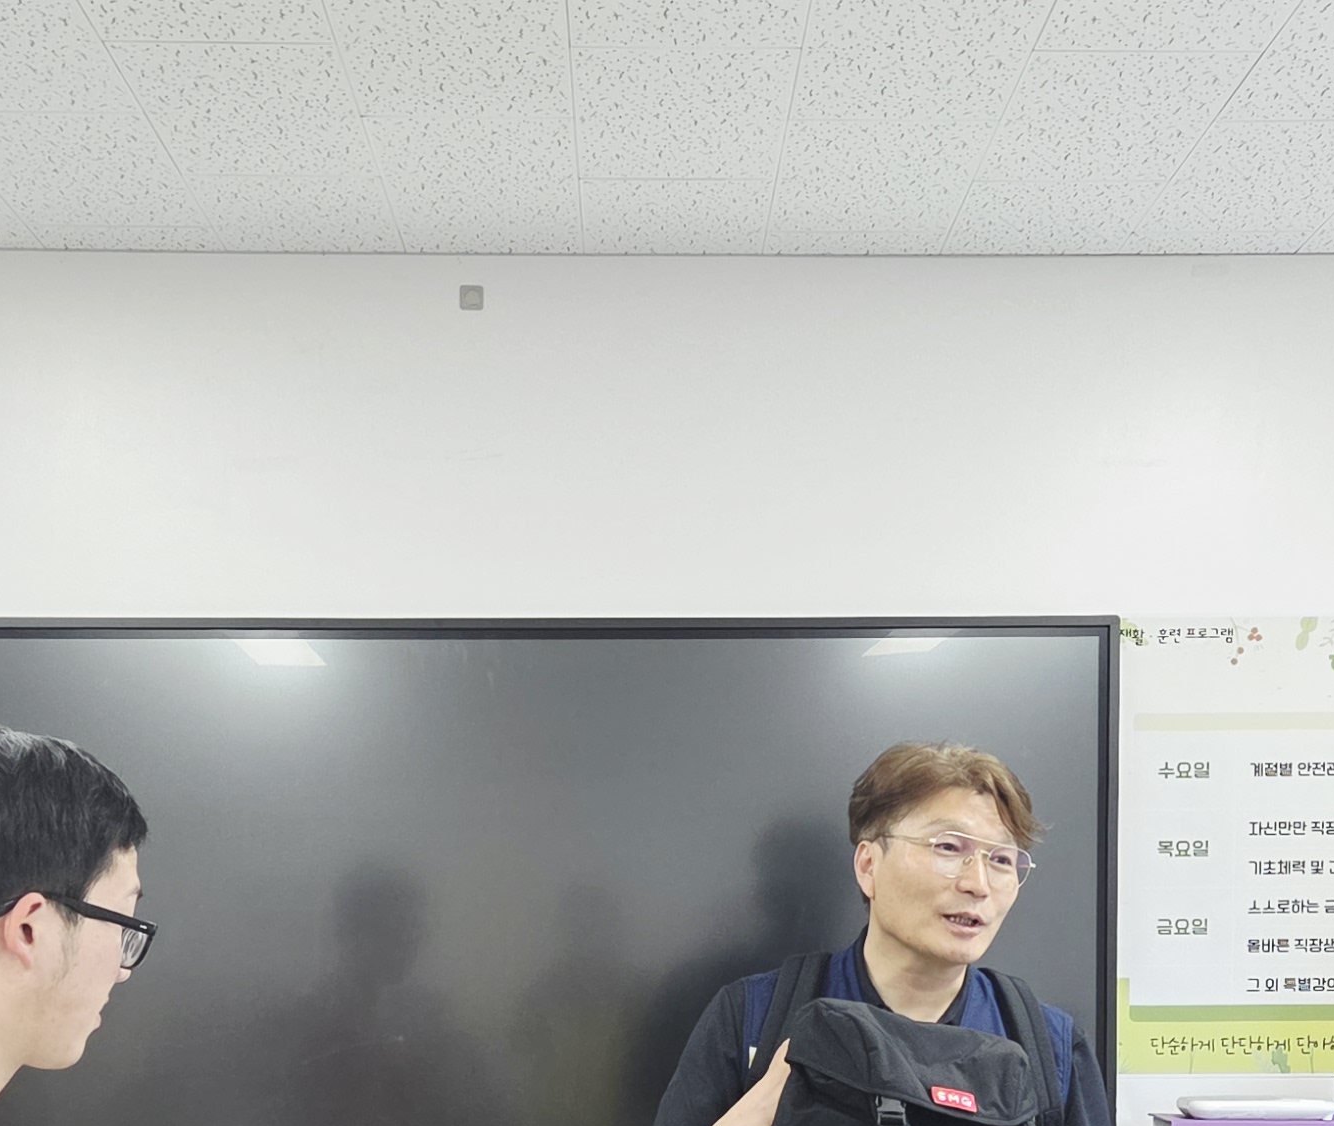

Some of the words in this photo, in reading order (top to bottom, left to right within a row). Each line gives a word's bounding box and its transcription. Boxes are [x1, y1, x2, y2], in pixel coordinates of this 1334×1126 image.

[1157, 628, 1181, 644] 훈련
[1185, 628, 1233, 644] 프로그램
[1158, 761, 1210, 779] 수요일
[1250, 762, 1293, 777] 계절별
[1249, 821, 1307, 836] 자신만만
[1157, 840, 1209, 857] 목요일
[1249, 860, 1305, 875] 기초체력
[1311, 860, 1324, 875] 및
[1248, 899, 1319, 914] 스스로하는
[1157, 918, 1208, 935] 금요일
[1248, 938, 1290, 953] 올바른
[1246, 978, 1260, 992] 그
[1265, 978, 1279, 992] 외
[1150, 1037, 1215, 1055] 단순하게
[1221, 1036, 1291, 1055] 단단하게
